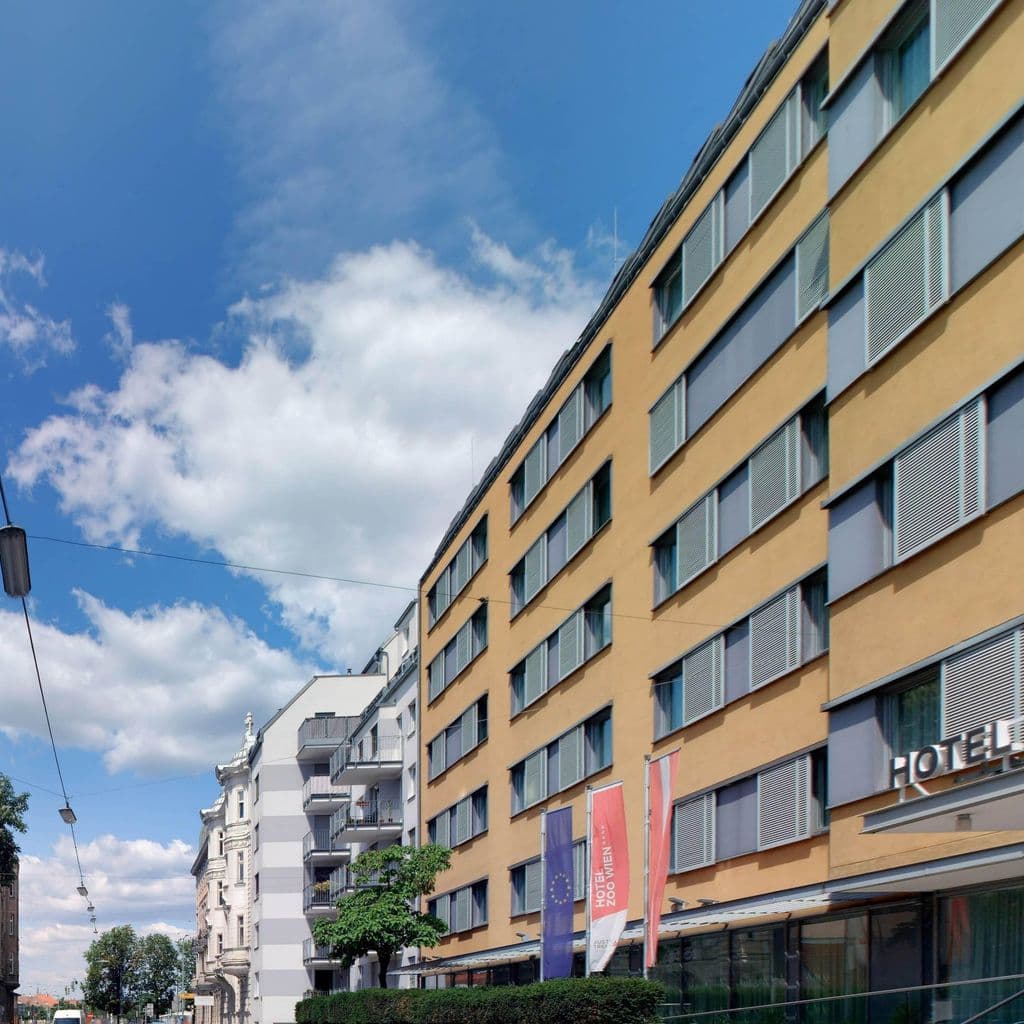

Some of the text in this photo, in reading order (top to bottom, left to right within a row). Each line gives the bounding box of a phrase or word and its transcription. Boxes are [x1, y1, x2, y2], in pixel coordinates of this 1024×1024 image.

[889, 720, 1013, 789] HOTEL
[595, 868, 605, 908] HOTEL
[602, 846, 616, 907] ZOO WIEN
